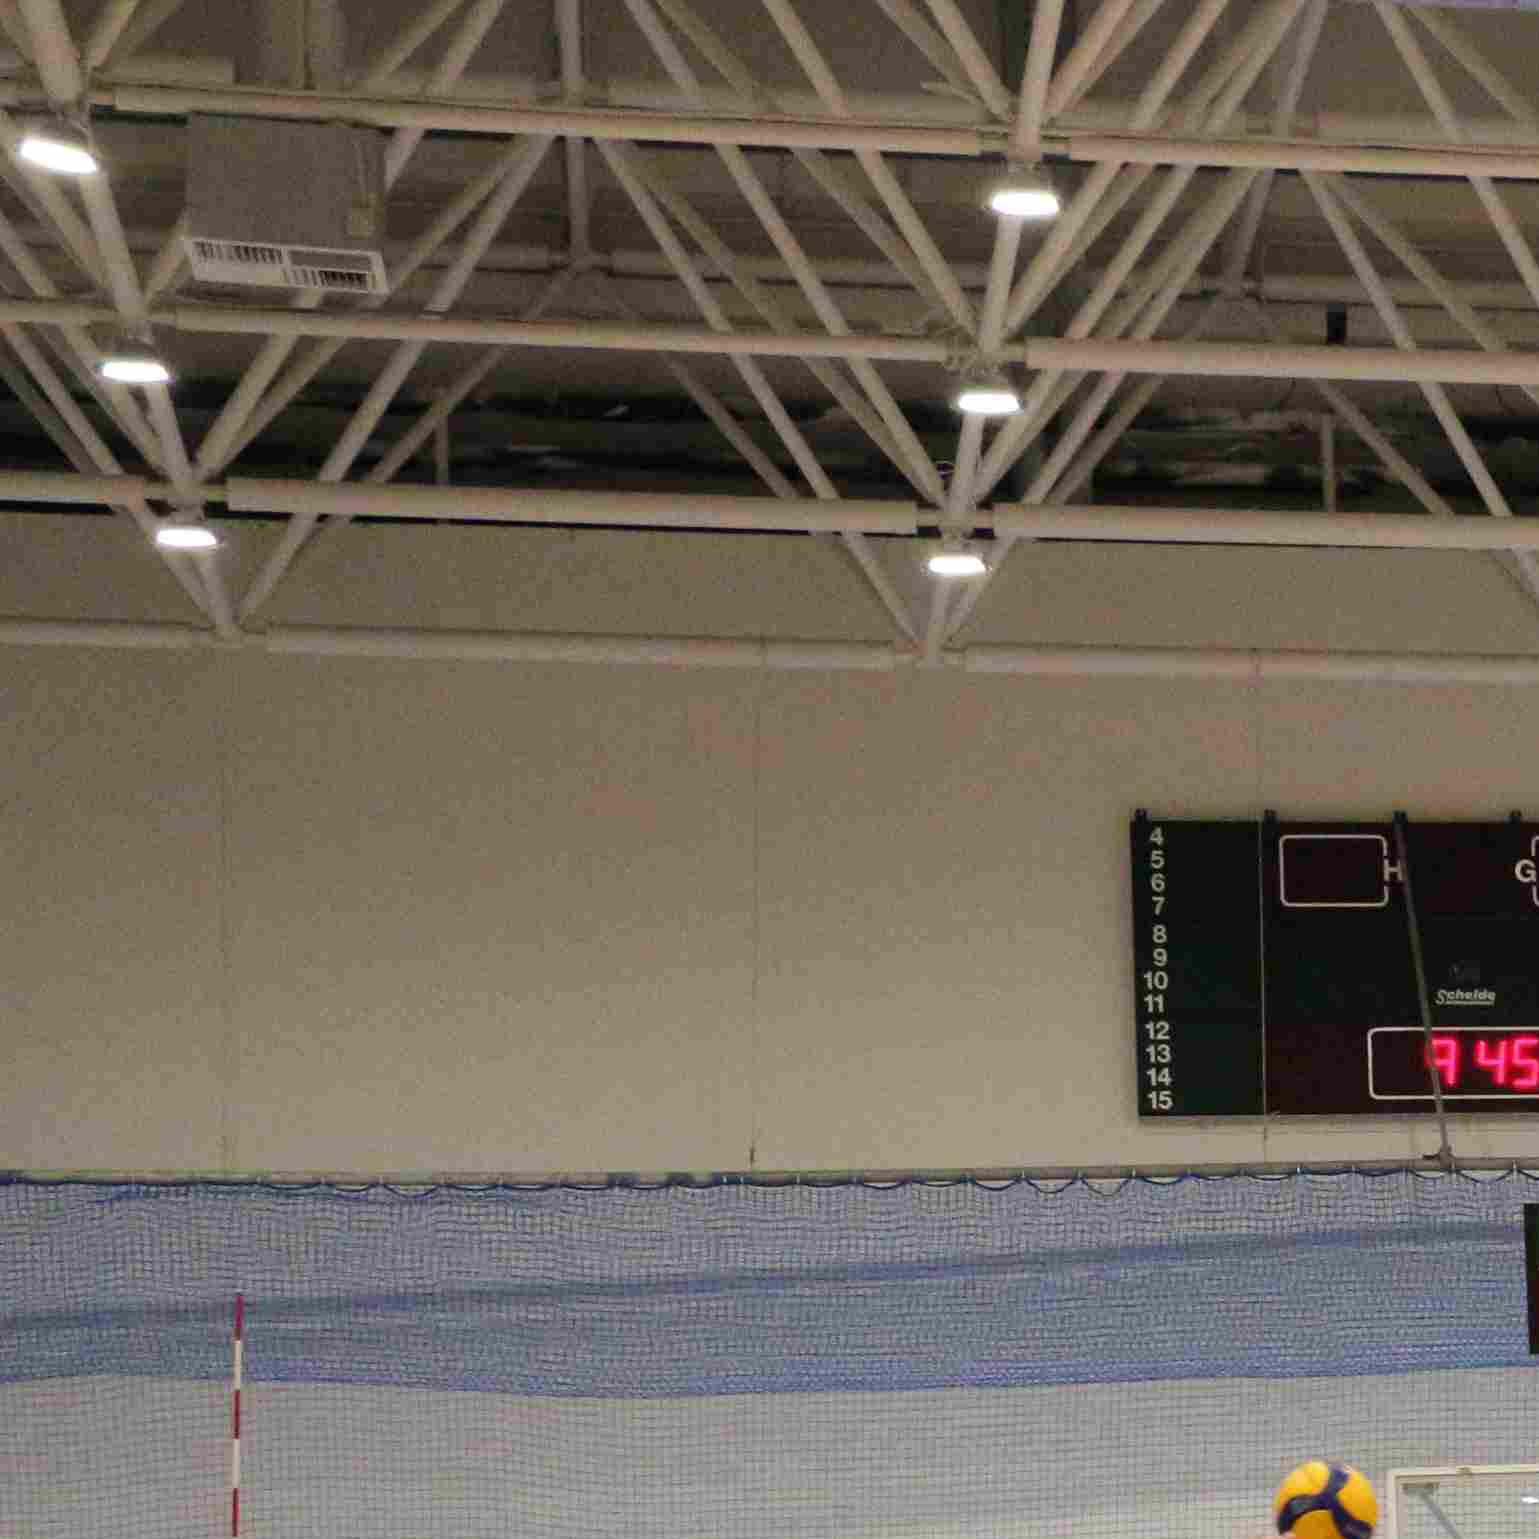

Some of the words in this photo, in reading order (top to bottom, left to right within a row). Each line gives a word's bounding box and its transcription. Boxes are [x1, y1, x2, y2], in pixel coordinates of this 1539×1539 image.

[1149, 827, 1164, 845] 4
[1151, 850, 1165, 869] 5
[1383, 859, 1405, 882] H
[1514, 859, 1537, 883] G
[1151, 873, 1166, 892] 6
[1152, 896, 1166, 915] 7
[1152, 924, 1167, 944] 8
[1153, 948, 1168, 967] 9
[1143, 970, 1169, 990] 10
[1144, 994, 1165, 1013] 11
[1435, 988, 1496, 1005] Schelde
[1145, 1021, 1170, 1040] 12
[1145, 1043, 1172, 1063] 13
[1146, 1067, 1173, 1086] 14
[1147, 1090, 1174, 1110] 15
